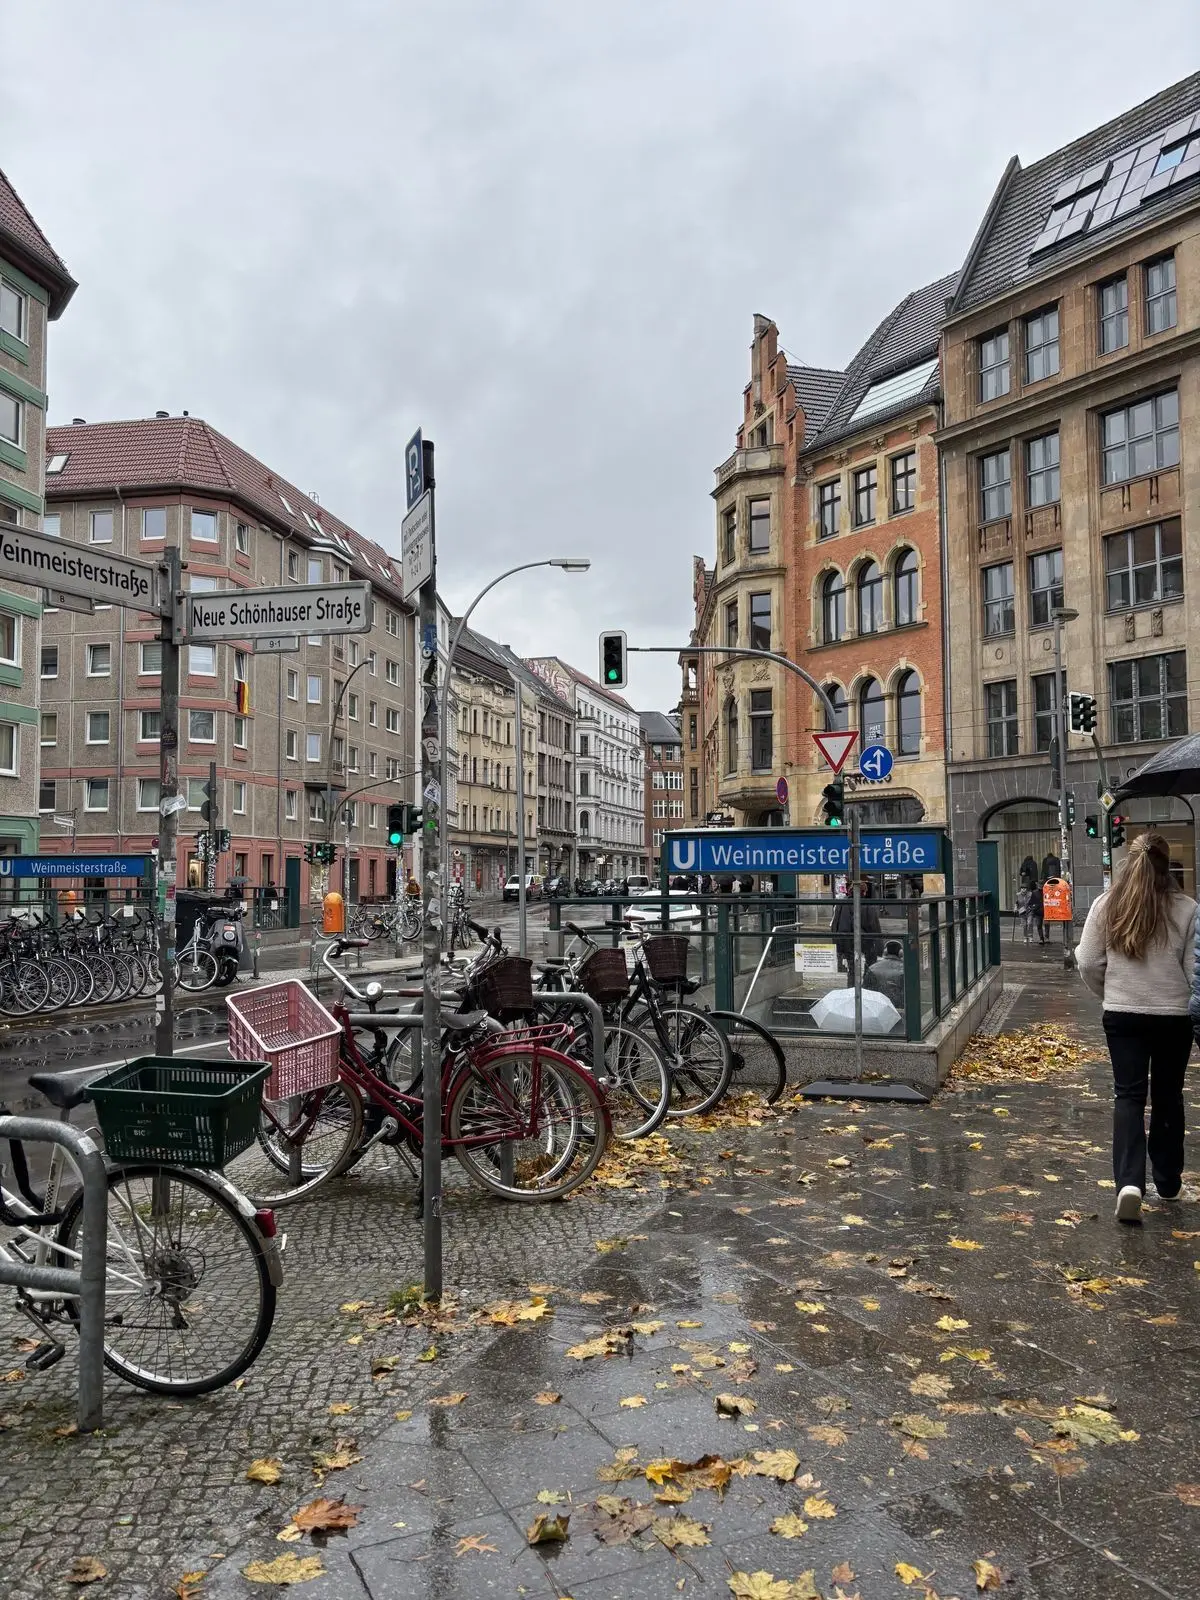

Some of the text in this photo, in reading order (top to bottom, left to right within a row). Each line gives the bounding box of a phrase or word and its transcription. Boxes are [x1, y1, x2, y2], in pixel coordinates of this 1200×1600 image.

[0, 534, 148, 597] einmeisterstraße
[193, 596, 361, 627] Neue Schönhauser Straße
[0, 860, 127, 875] U Weinmeisterstraße
[672, 840, 925, 869] U Weinmeistertraße
